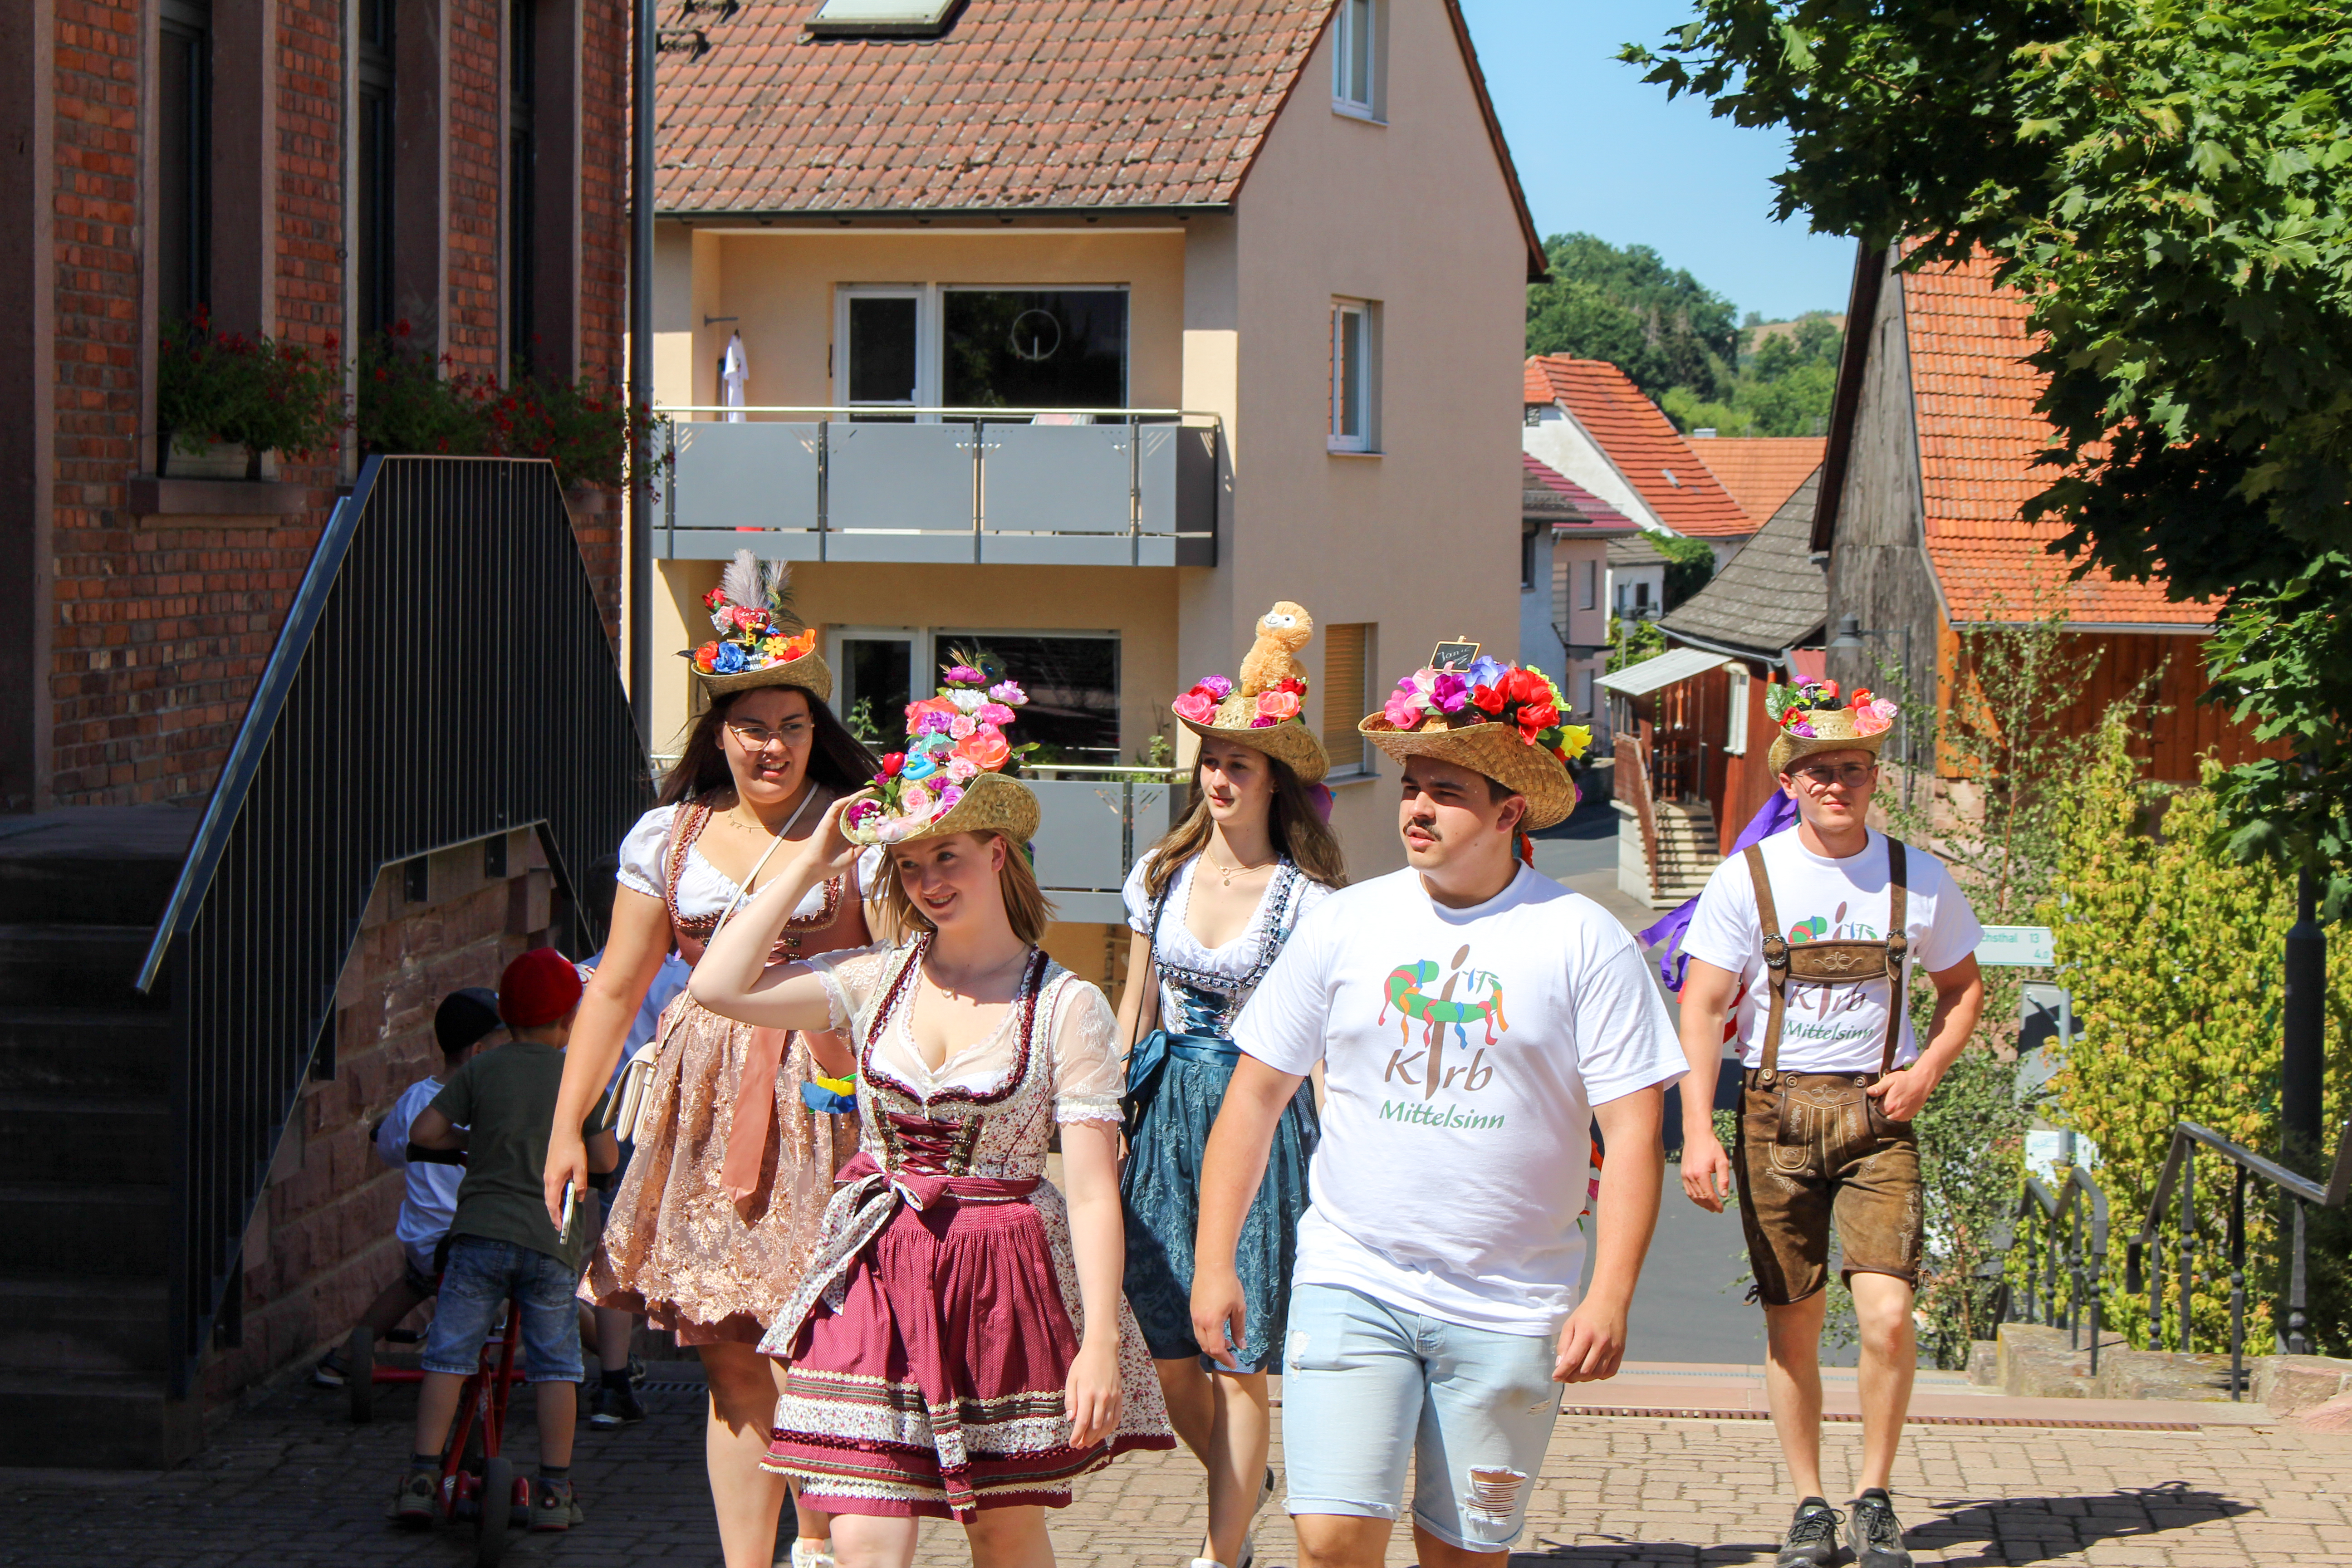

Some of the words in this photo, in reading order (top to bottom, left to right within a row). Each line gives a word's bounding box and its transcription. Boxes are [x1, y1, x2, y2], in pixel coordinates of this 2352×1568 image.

[744, 652, 764, 662] UME
[1981, 933, 2018, 943] chsthal
[2029, 933, 2040, 943] 13
[1783, 1021, 1873, 1040] Mittelsinn
[1385, 1048, 1493, 1100] Kirb
[1379, 1099, 1505, 1129] Mittelsinn
